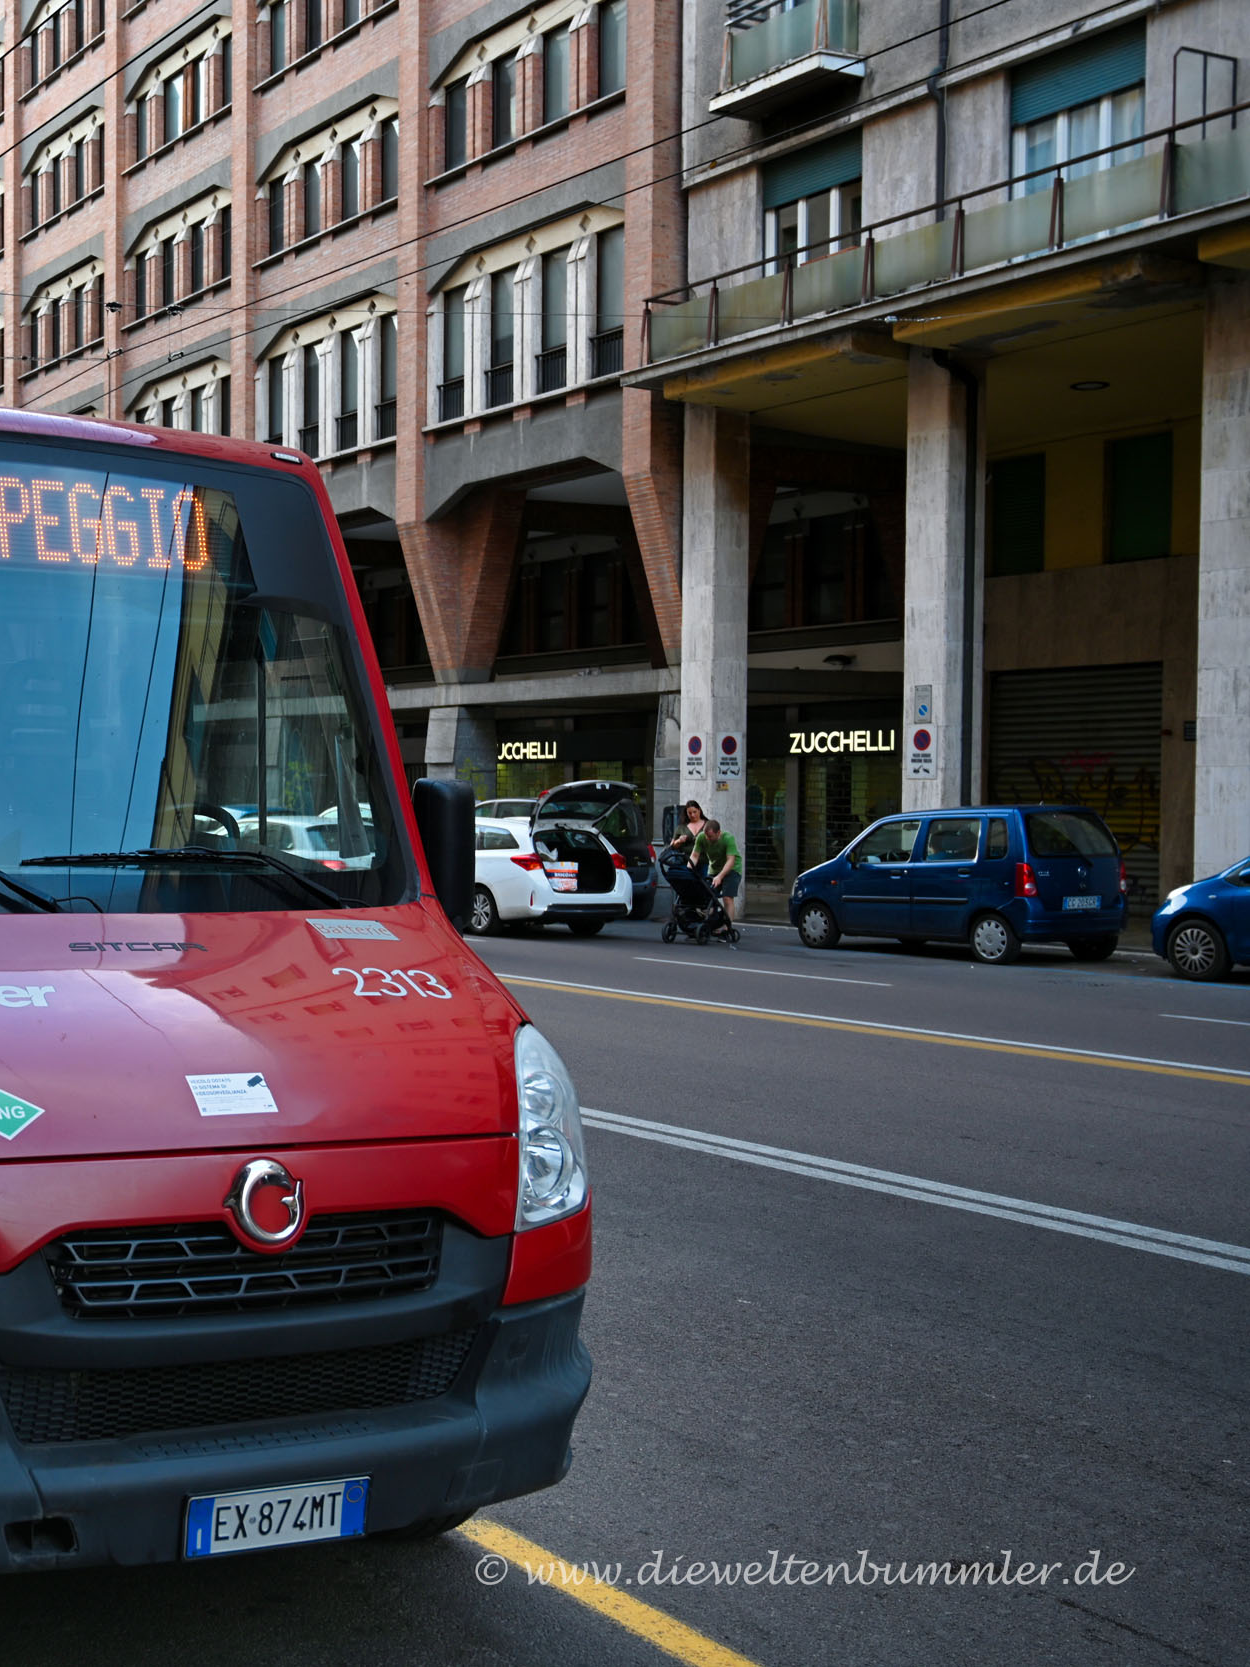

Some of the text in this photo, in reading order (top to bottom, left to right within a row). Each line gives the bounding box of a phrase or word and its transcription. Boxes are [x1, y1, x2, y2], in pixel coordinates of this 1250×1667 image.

[497, 740, 557, 761] UCCHELLI
[789, 729, 895, 754] ZUCCHELLI
[312, 921, 392, 937] Batterie
[68, 942, 209, 952] SITCAR
[331, 966, 453, 999] 2313
